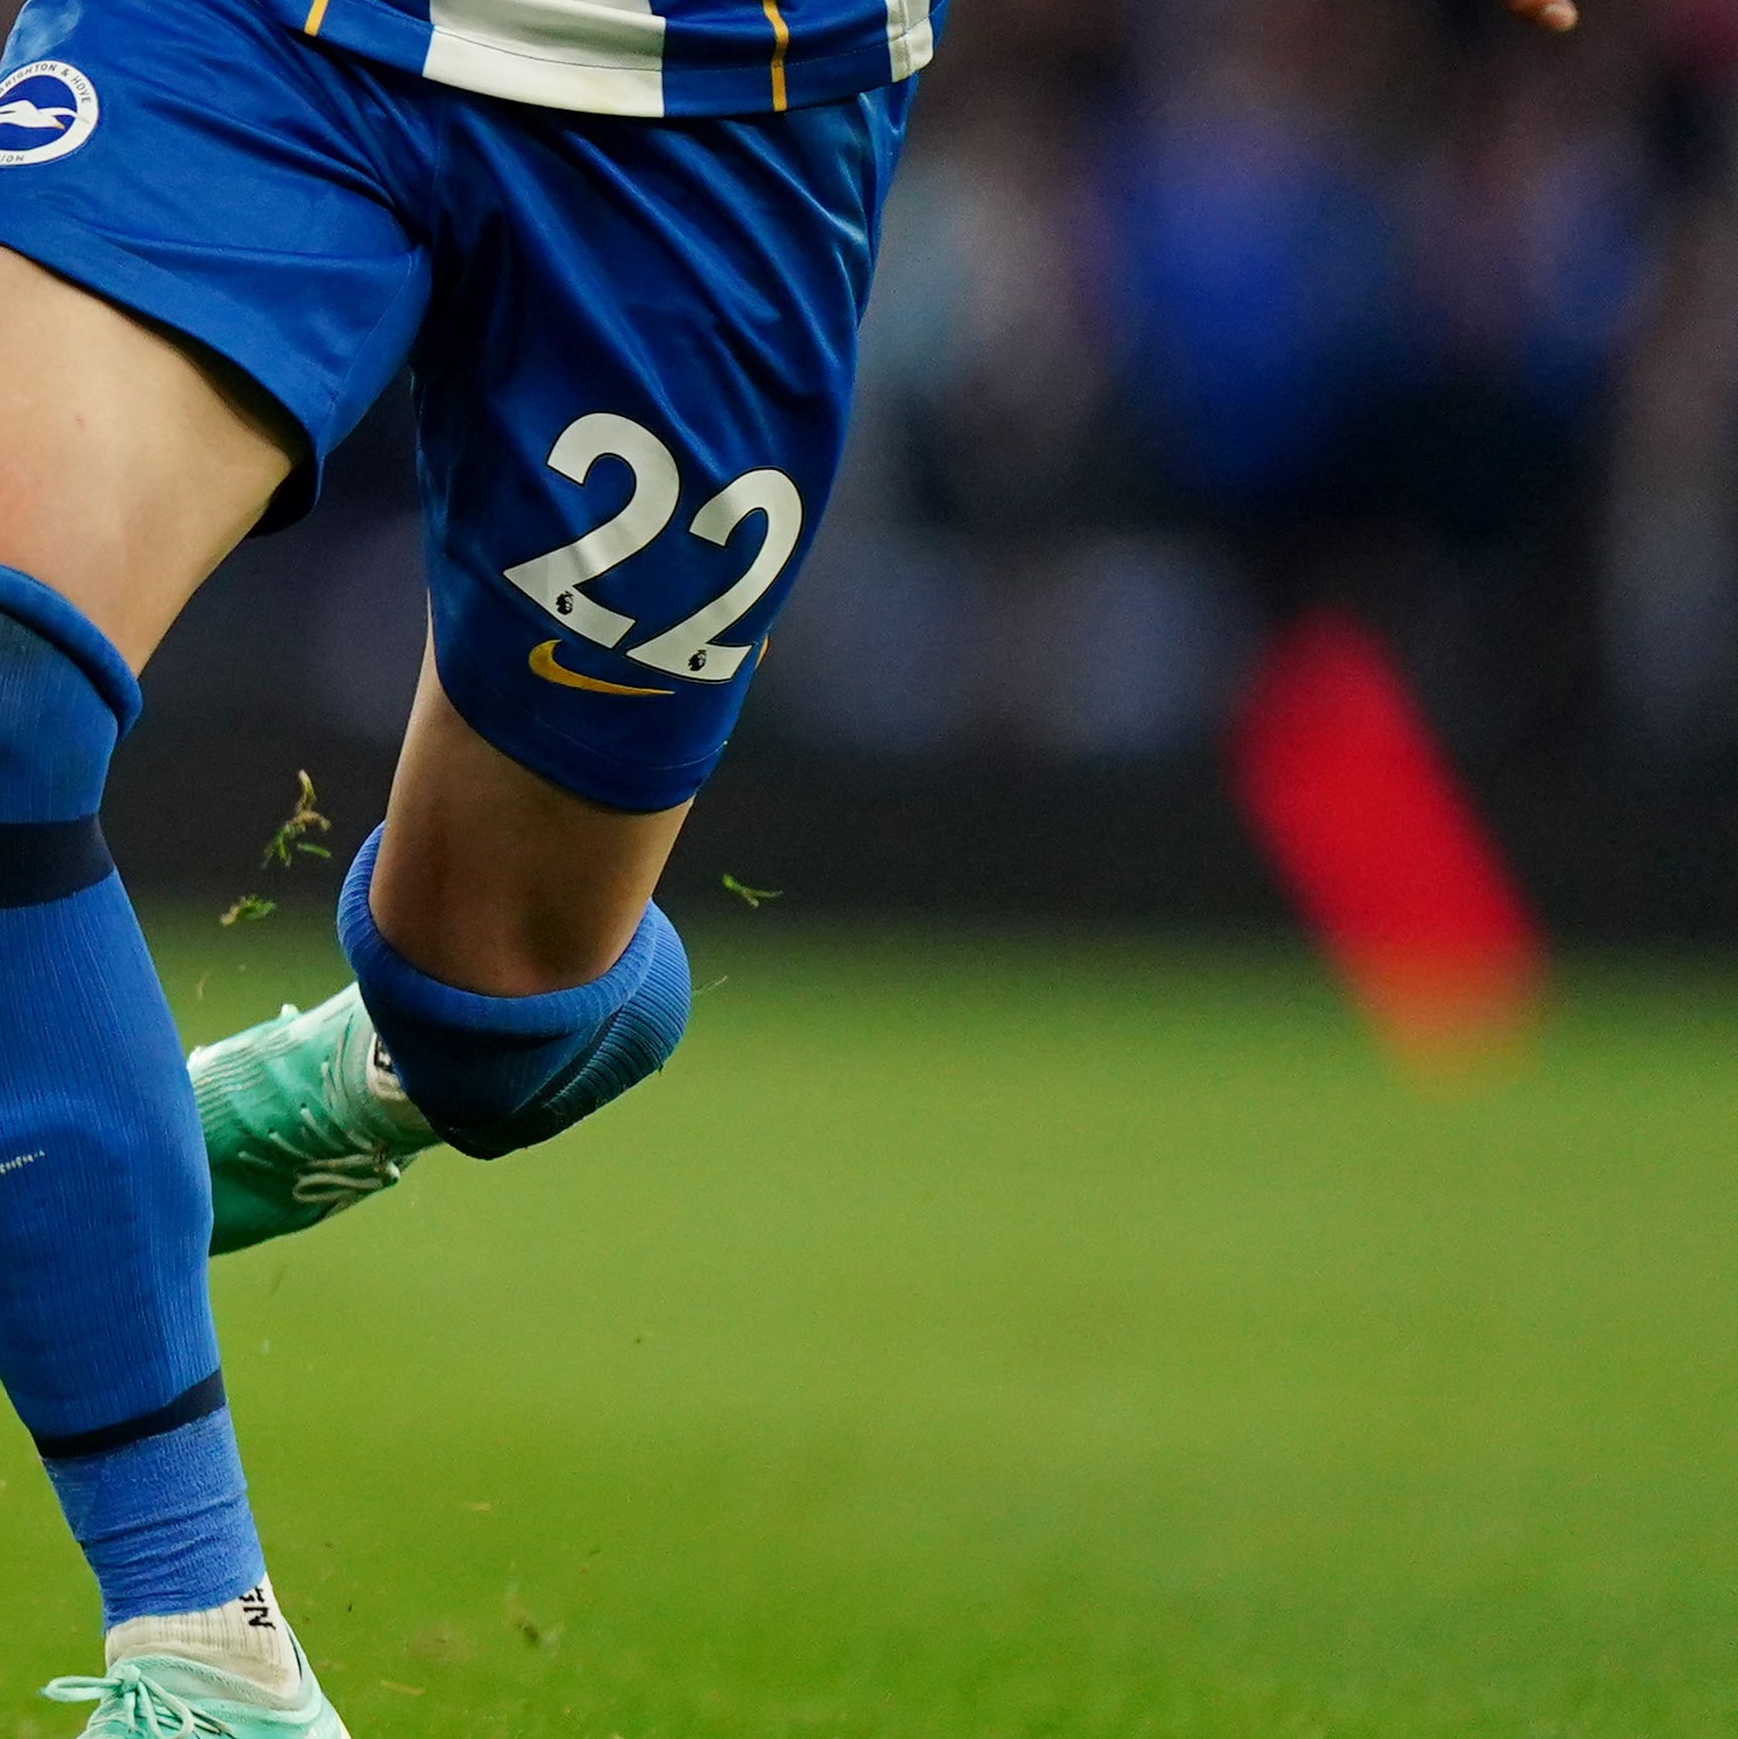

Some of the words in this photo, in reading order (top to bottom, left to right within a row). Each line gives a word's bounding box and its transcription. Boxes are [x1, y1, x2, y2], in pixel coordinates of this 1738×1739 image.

[61, 67, 70, 77] &
[73, 76, 92, 103] HOVE
[503, 412, 804, 682] 22
